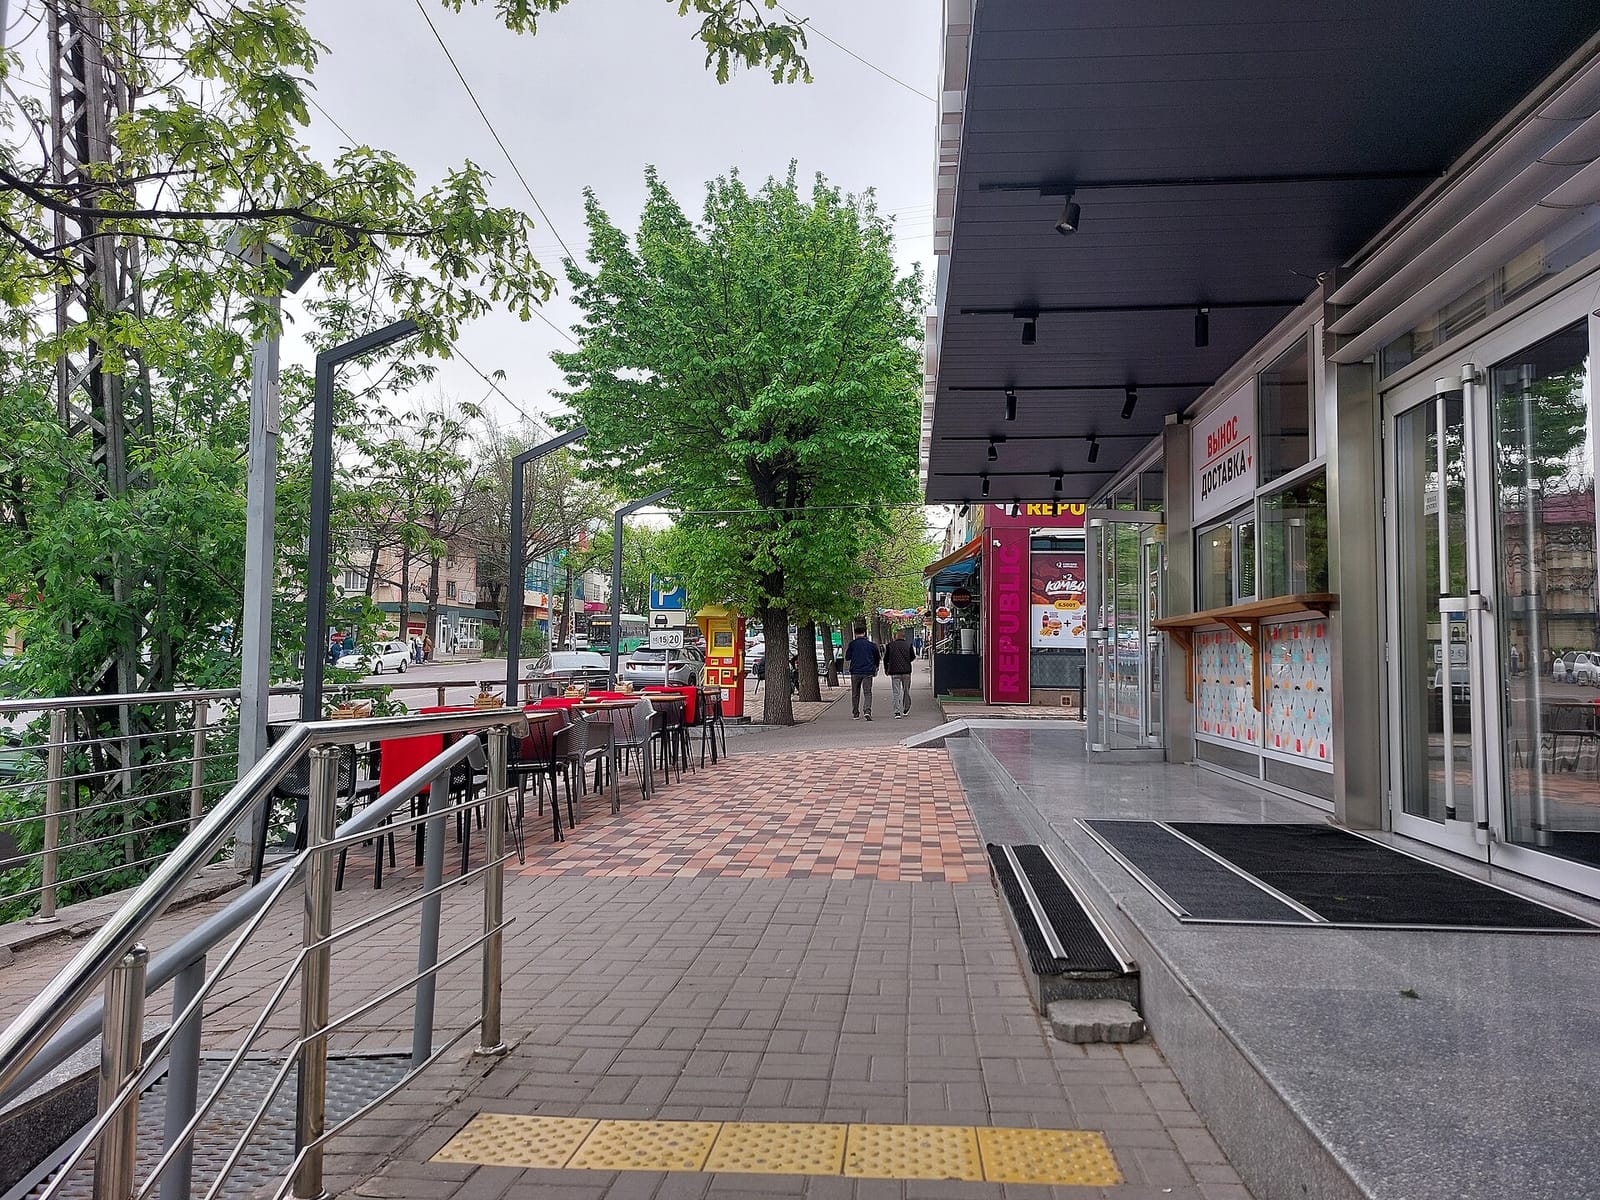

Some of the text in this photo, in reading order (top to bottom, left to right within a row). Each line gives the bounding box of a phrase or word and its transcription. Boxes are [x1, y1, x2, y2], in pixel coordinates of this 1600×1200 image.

[1207, 415, 1238, 459] ВЫНОС
[1201, 449, 1247, 502] ДОСТАВКА
[669, 634, 679, 644] 20
[999, 544, 1022, 694] REPUBLIC
